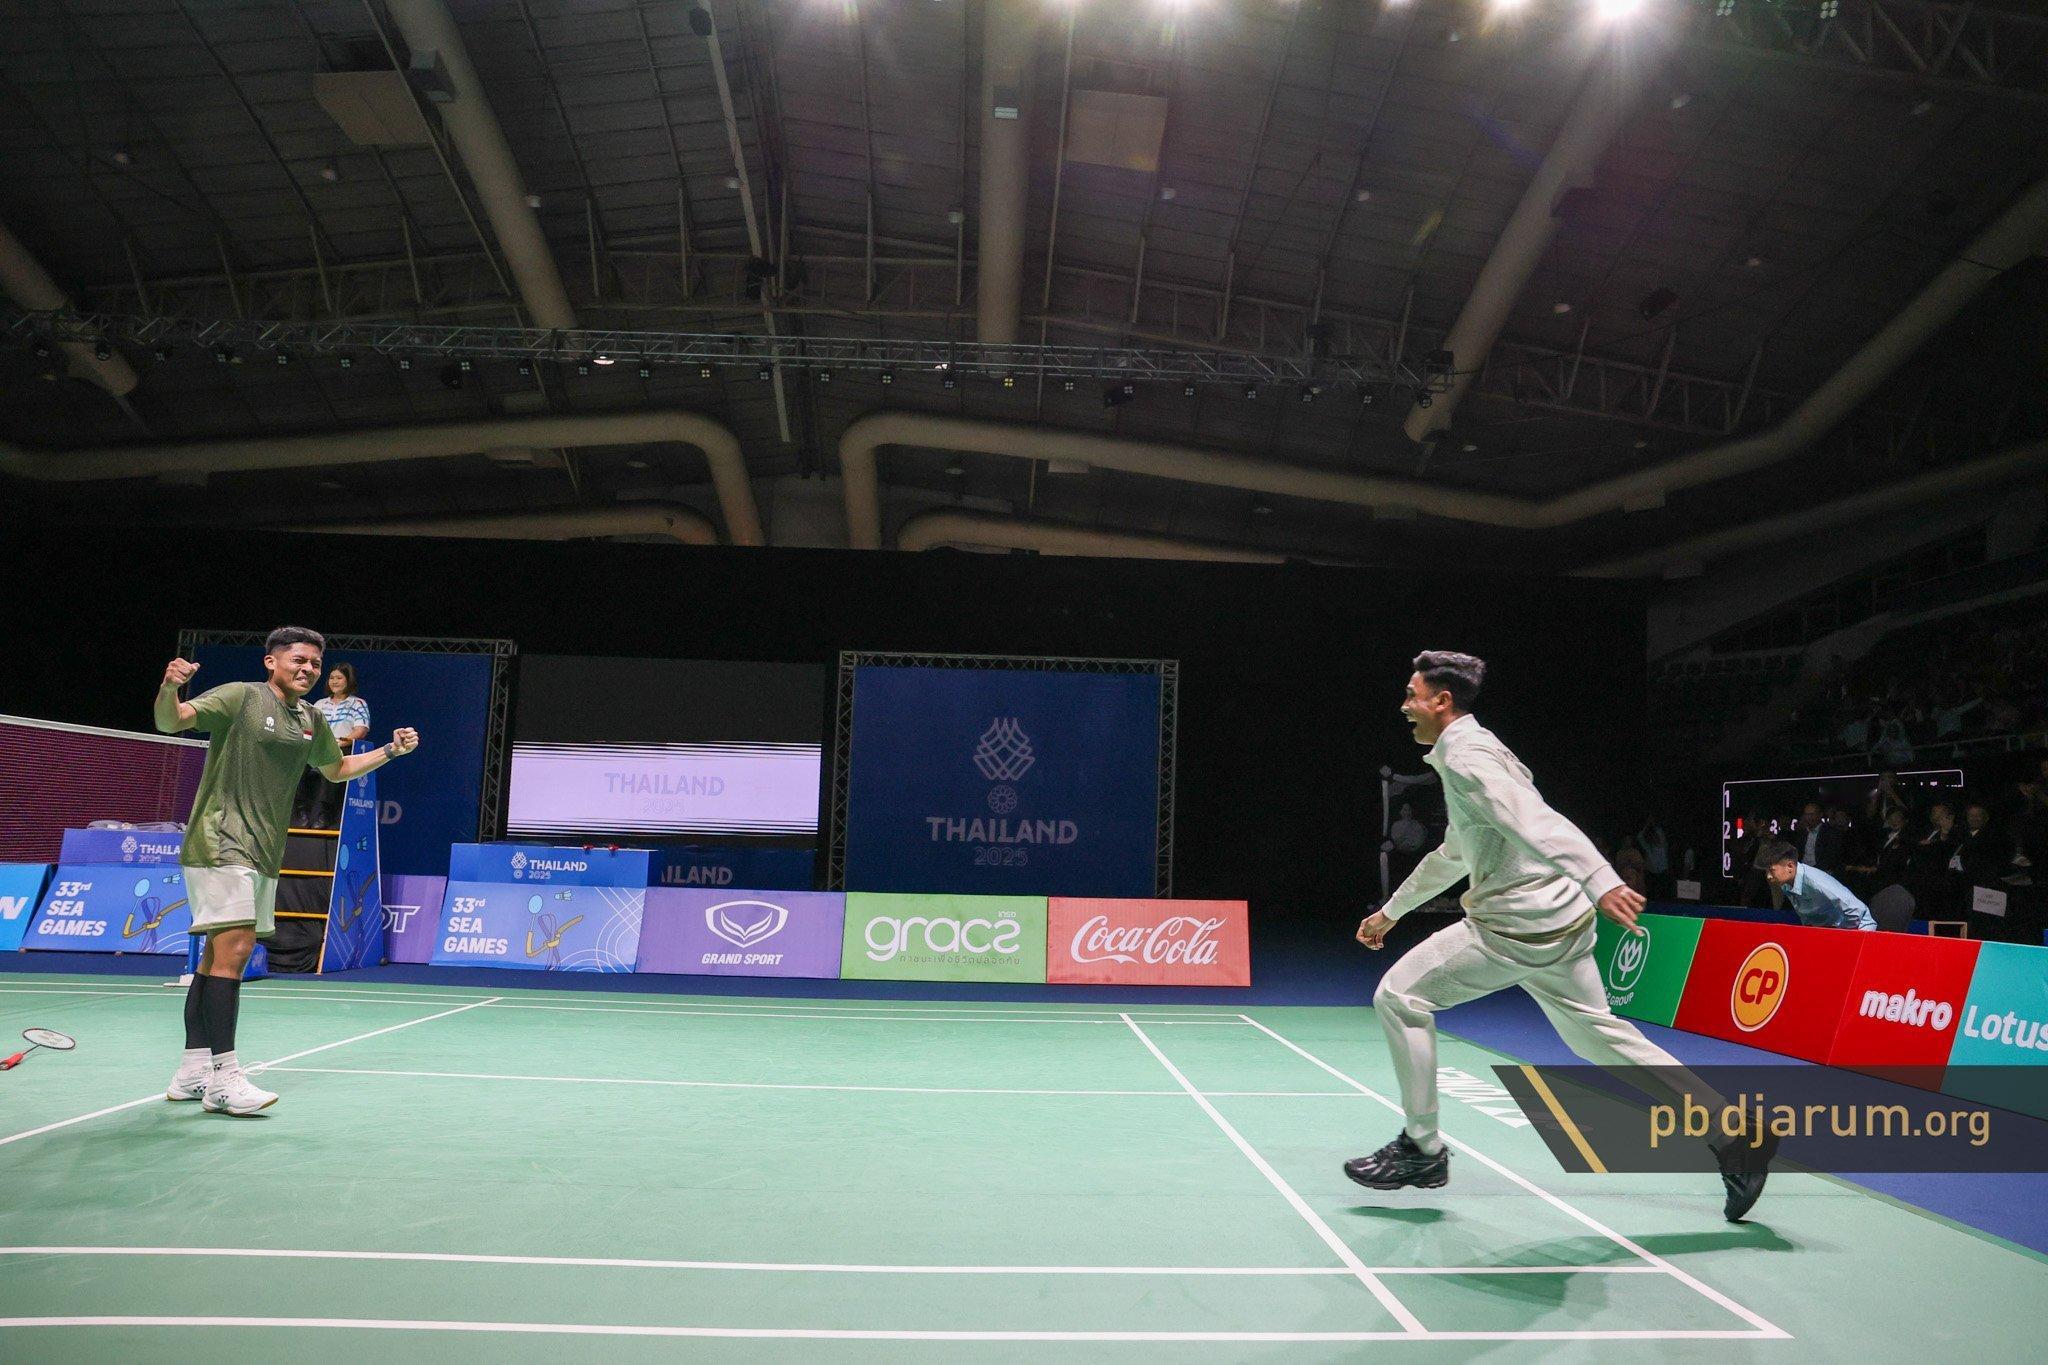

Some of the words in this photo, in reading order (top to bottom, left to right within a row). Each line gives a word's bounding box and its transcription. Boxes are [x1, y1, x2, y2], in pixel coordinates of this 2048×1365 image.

[604, 772, 725, 796] THAILAND
[348, 797, 374, 809] THAILAND
[926, 816, 1079, 844] THAILAND
[529, 859, 588, 872] THAILAND
[974, 847, 1029, 867] 2025
[528, 870, 551, 880] 2025
[55, 881, 93, 897] 33rd
[46, 900, 84, 916] SEA
[452, 897, 487, 914] 33rd
[37, 919, 108, 937] GAMES
[448, 917, 483, 934] SEA
[443, 937, 509, 955] GAMES
[1070, 915, 1227, 965] Coca-Cola
[701, 953, 742, 965] GRAND
[744, 954, 783, 965] SPORT
[1739, 968, 1780, 1005] CP
[1859, 988, 1953, 1031] makro
[1964, 1005, 2048, 1051] Lotus
